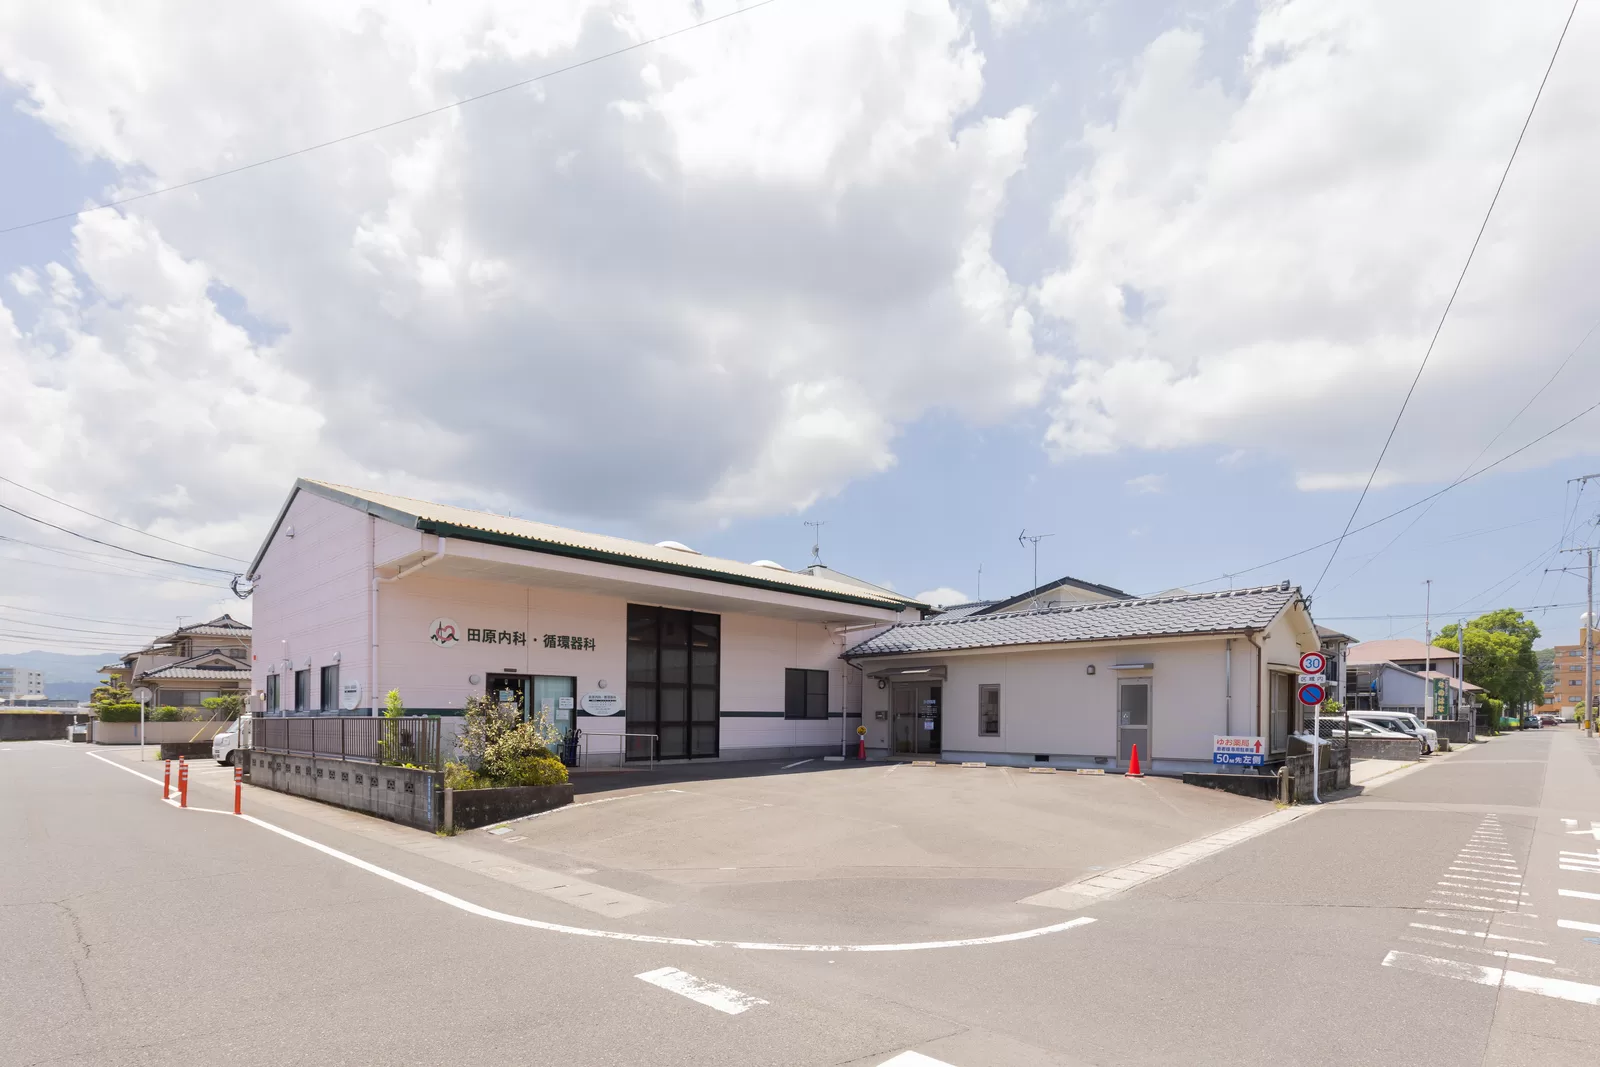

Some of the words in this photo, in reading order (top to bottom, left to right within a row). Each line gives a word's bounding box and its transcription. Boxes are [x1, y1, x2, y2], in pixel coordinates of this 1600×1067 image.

[467, 628, 596, 651] 田原内科・循環器科
[1305, 658, 1320, 669] 30
